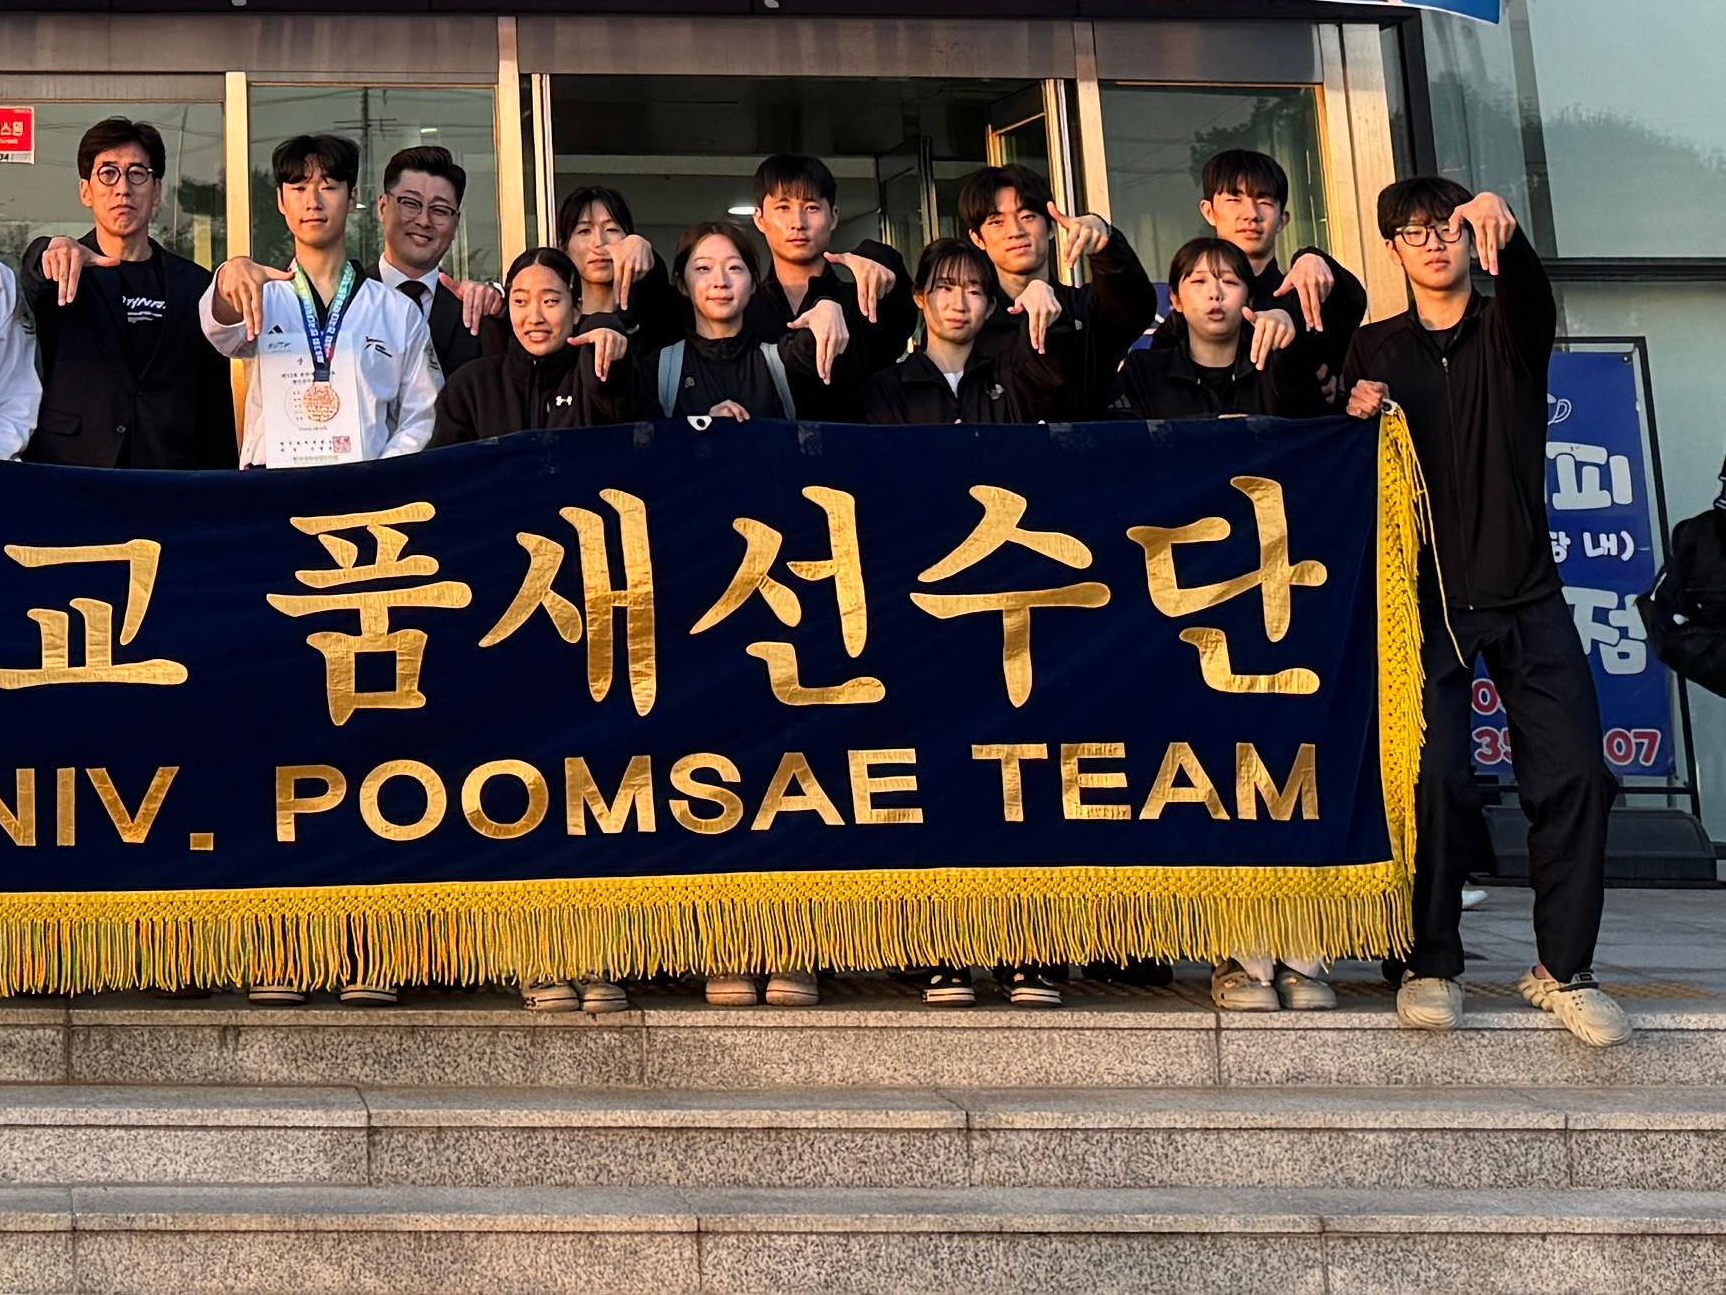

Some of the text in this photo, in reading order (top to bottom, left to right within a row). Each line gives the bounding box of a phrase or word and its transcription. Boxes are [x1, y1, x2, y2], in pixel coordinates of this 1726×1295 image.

[1545, 441, 1633, 510] 피
[266, 475, 1328, 726] 품새선수단
[1561, 586, 1648, 674] 점
[274, 748, 924, 843] POOMSAE
[971, 742, 1321, 821] TEAM
